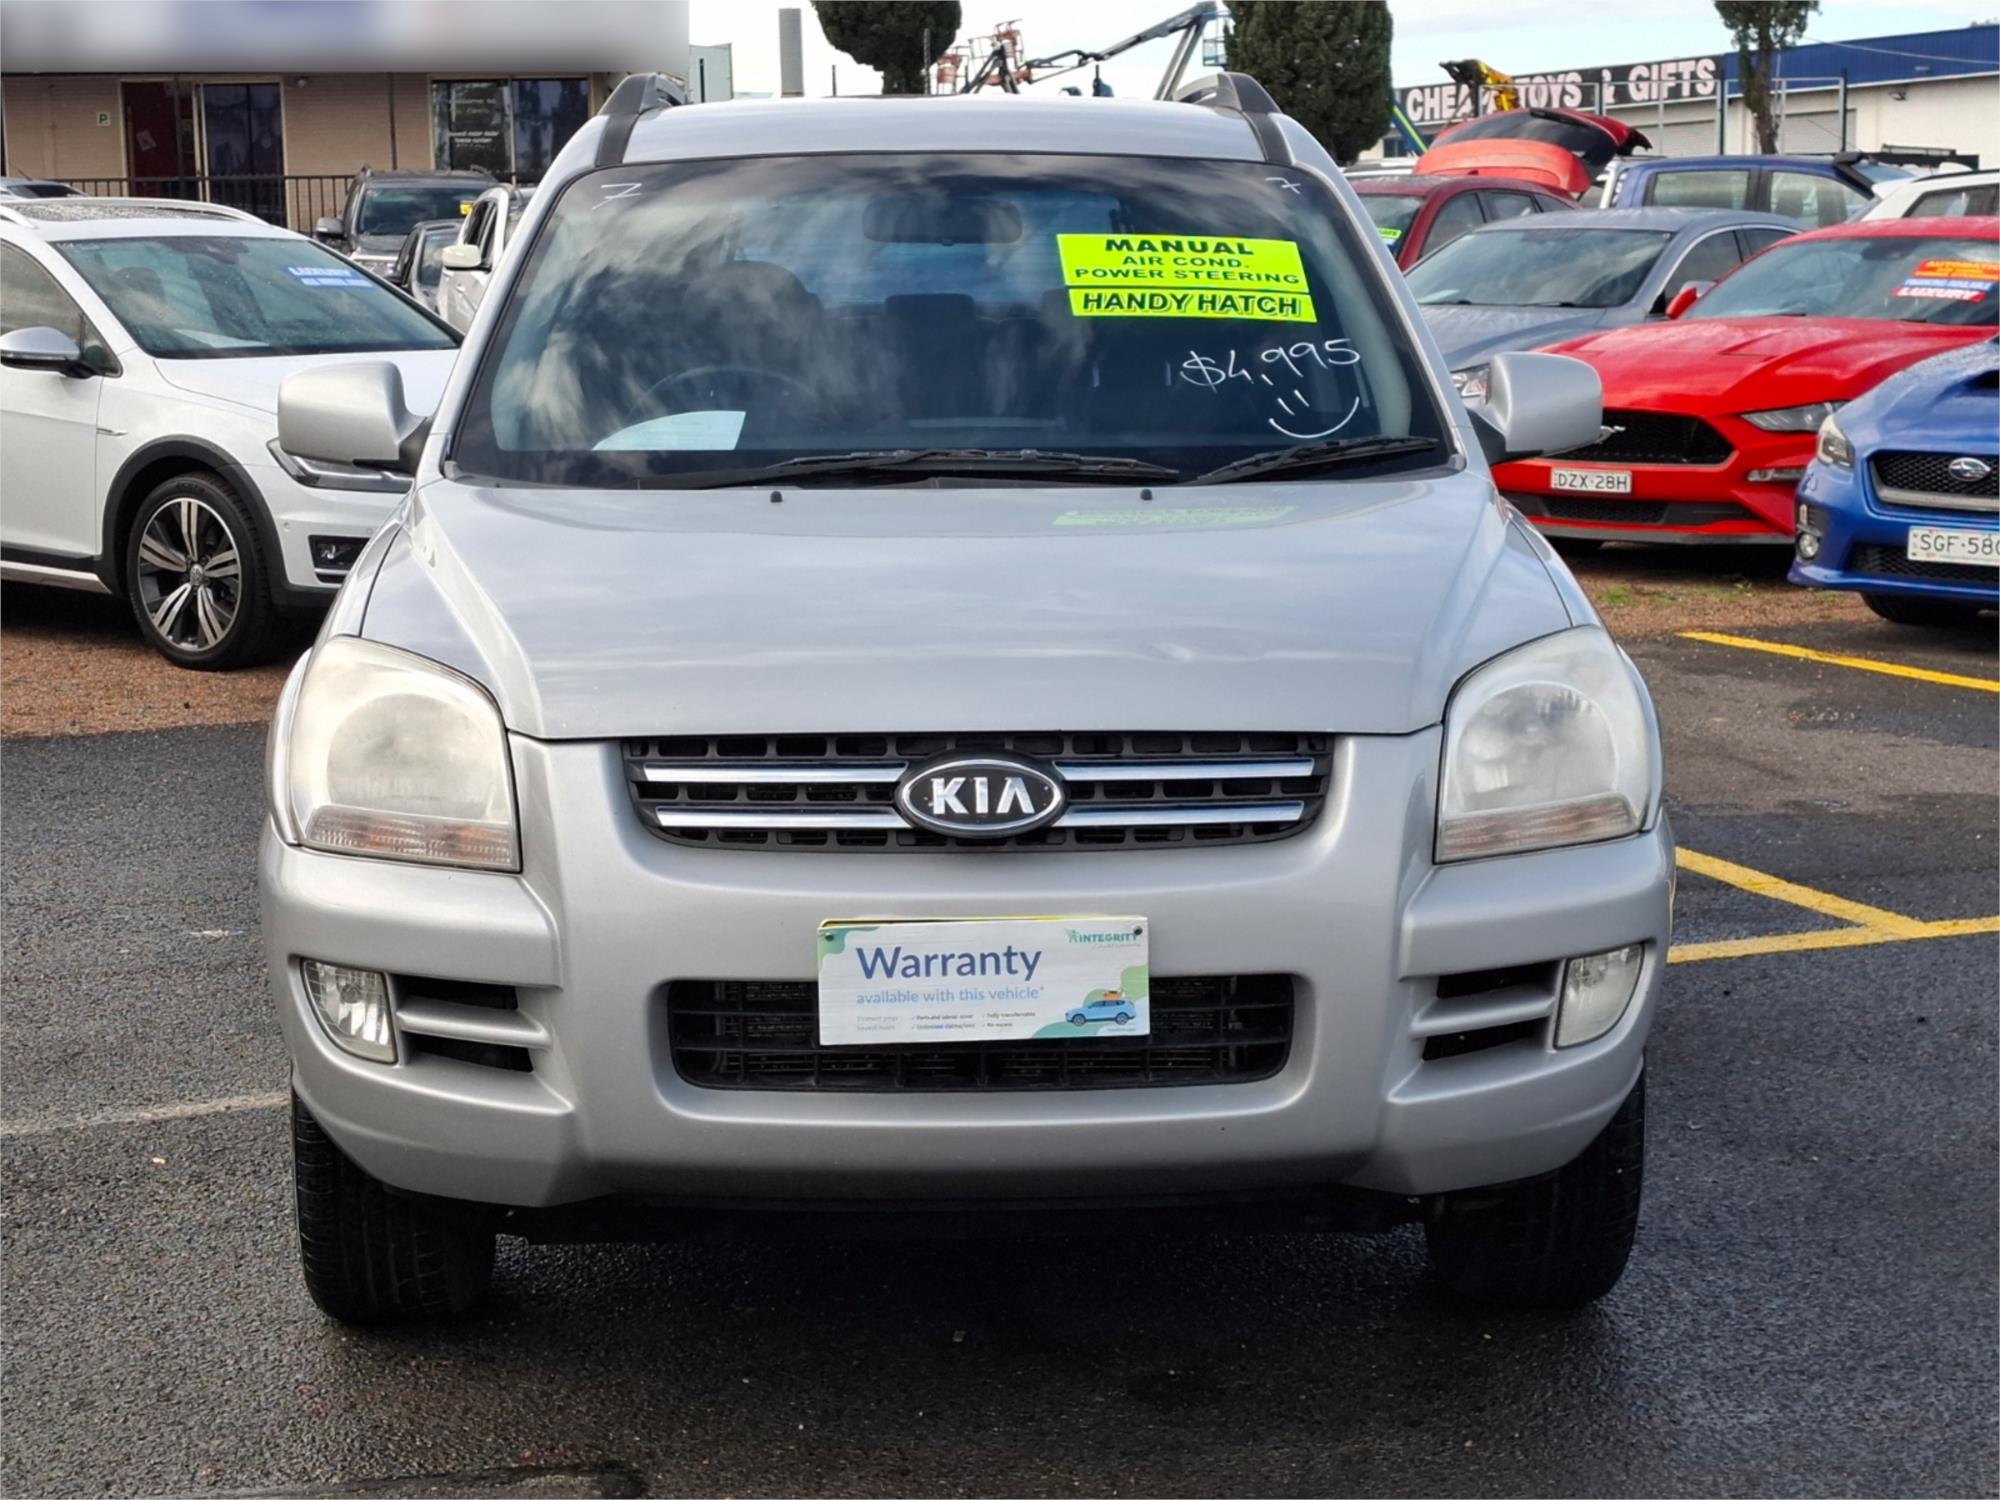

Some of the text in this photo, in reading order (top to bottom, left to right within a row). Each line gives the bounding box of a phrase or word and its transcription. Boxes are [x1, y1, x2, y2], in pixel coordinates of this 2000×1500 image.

[1515, 72, 1583, 109] TOYS
[1628, 58, 1716, 101] GIFTS
[1105, 239, 1254, 255] MANUAL
[1122, 256, 1250, 269] AIR COND.
[1075, 269, 1300, 284] POWER STEERING
[1083, 293, 1301, 316] HANDY HATCH
[1180, 338, 1361, 393] $4,995
[931, 777, 1035, 814] KIA
[856, 945, 1042, 982] Warranty
[857, 988, 920, 1005] available
[923, 986, 955, 1002] with
[959, 985, 985, 1001] this
